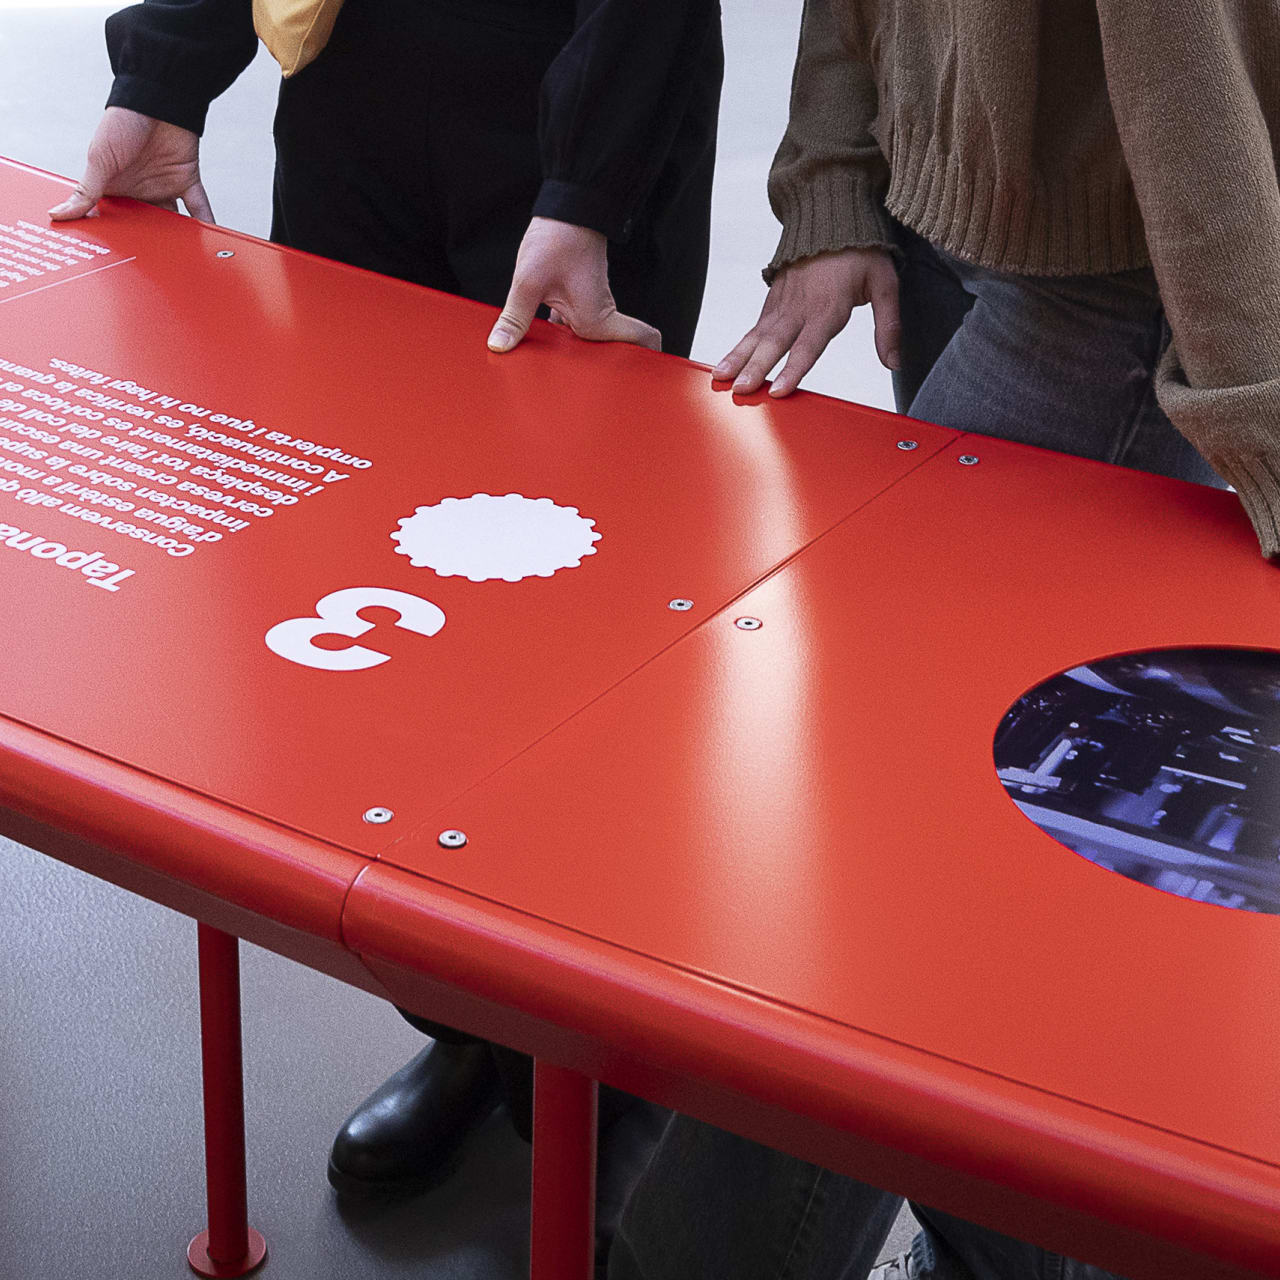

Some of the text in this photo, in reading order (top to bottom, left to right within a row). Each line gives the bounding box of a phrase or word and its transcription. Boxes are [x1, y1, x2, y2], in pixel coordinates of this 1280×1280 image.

[53, 381, 78, 394] la
[49, 358, 372, 469] omplerta i que no hi hagi fuites.
[74, 388, 155, 419] verifica
[17, 408, 66, 426] coll
[102, 417, 133, 430] es
[153, 415, 184, 428] es
[57, 423, 103, 439] del
[58, 440, 104, 460] una
[128, 426, 306, 488] immediatament
[184, 423, 324, 474] continuació,
[45, 456, 72, 470] la
[98, 455, 178, 485] creant
[151, 453, 191, 471] tot
[42, 475, 63, 485] a
[68, 464, 137, 491] sobre
[189, 465, 299, 505] desplaça
[322, 470, 350, 483] A
[15, 489, 64, 507] allò
[52, 481, 135, 511] estèril
[176, 481, 274, 517] cervesa
[304, 485, 324, 496] i
[134, 487, 250, 532] impacten
[58, 503, 195, 556] Conservem
[265, 587, 446, 671] 3
